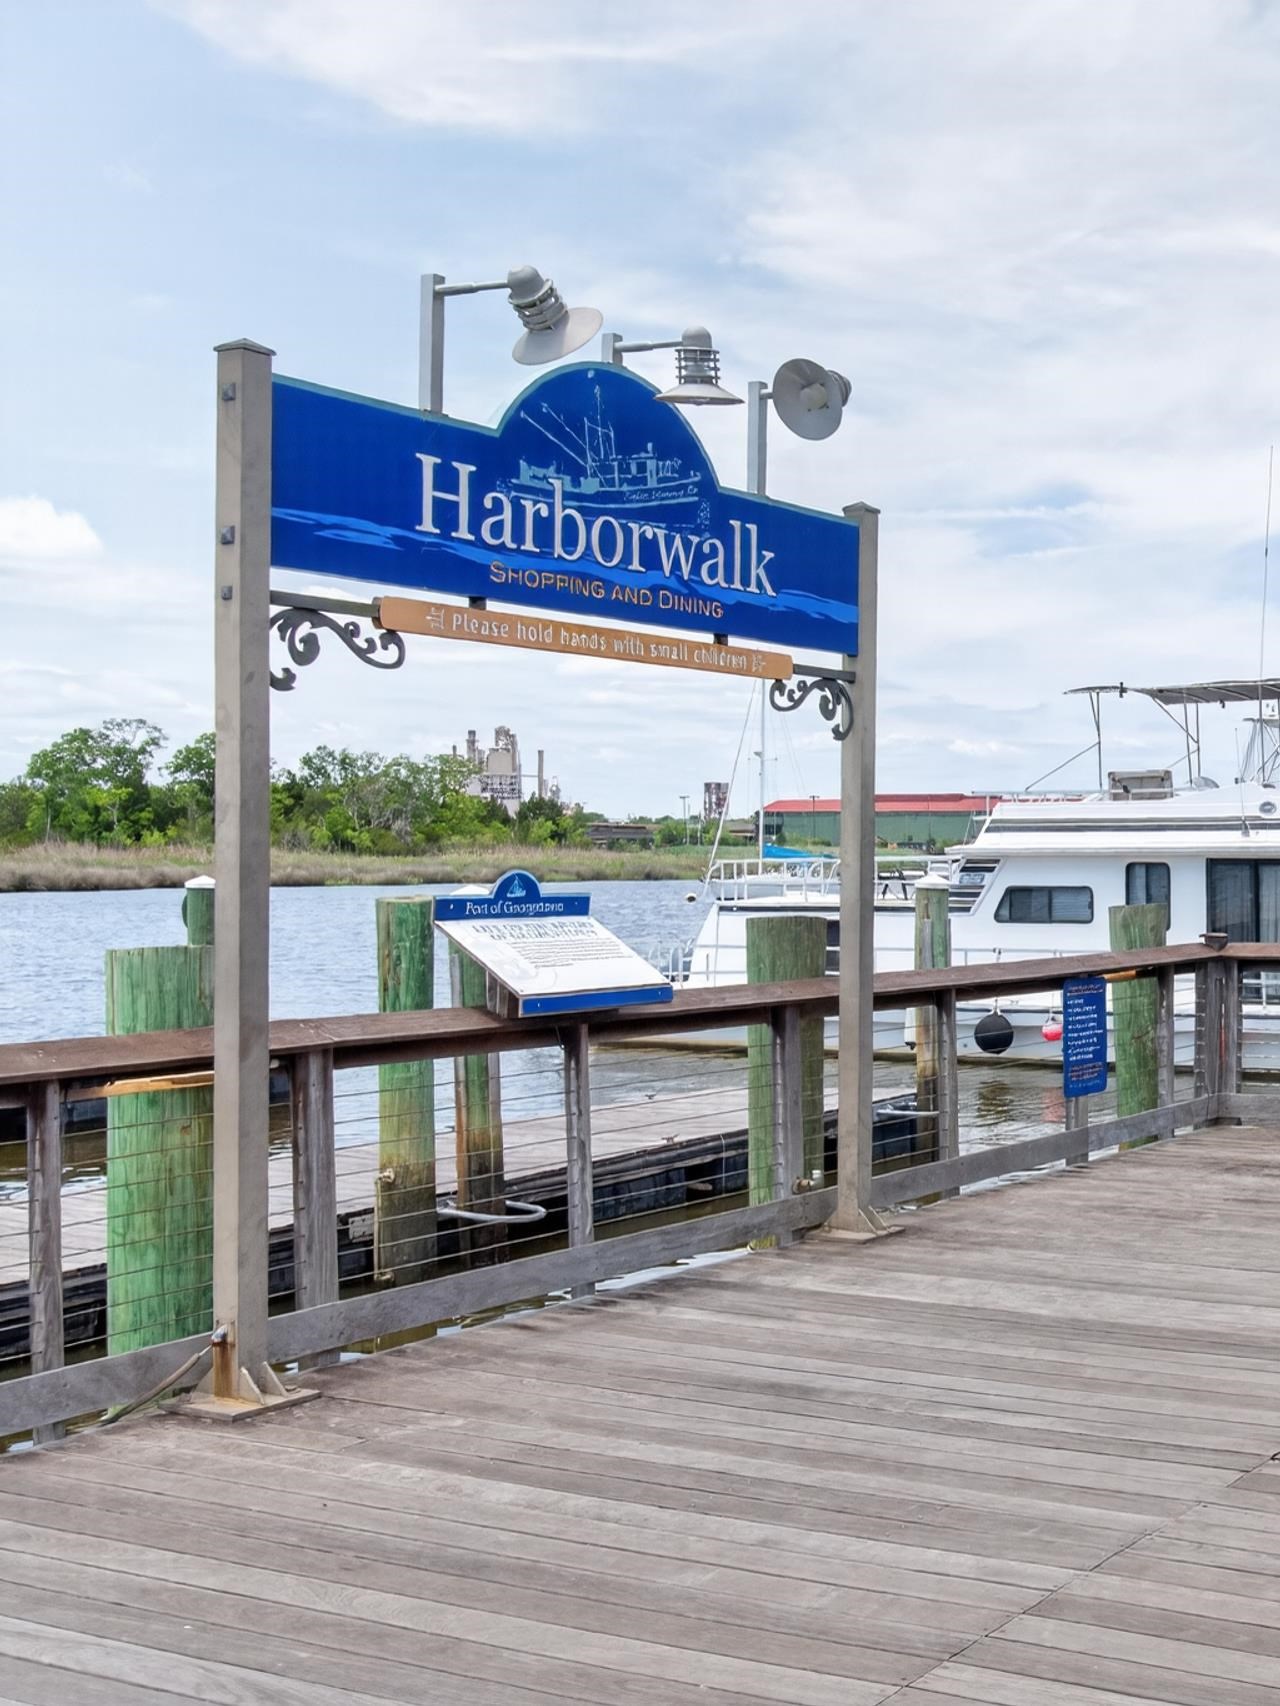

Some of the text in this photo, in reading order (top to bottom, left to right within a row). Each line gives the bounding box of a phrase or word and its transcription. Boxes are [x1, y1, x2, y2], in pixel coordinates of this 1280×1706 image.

[415, 452, 777, 598] Harborwalk
[489, 560, 724, 618] SHOPPING AND DINING
[452, 612, 748, 671] Please hold hands with small children
[490, 900, 503, 914] of
